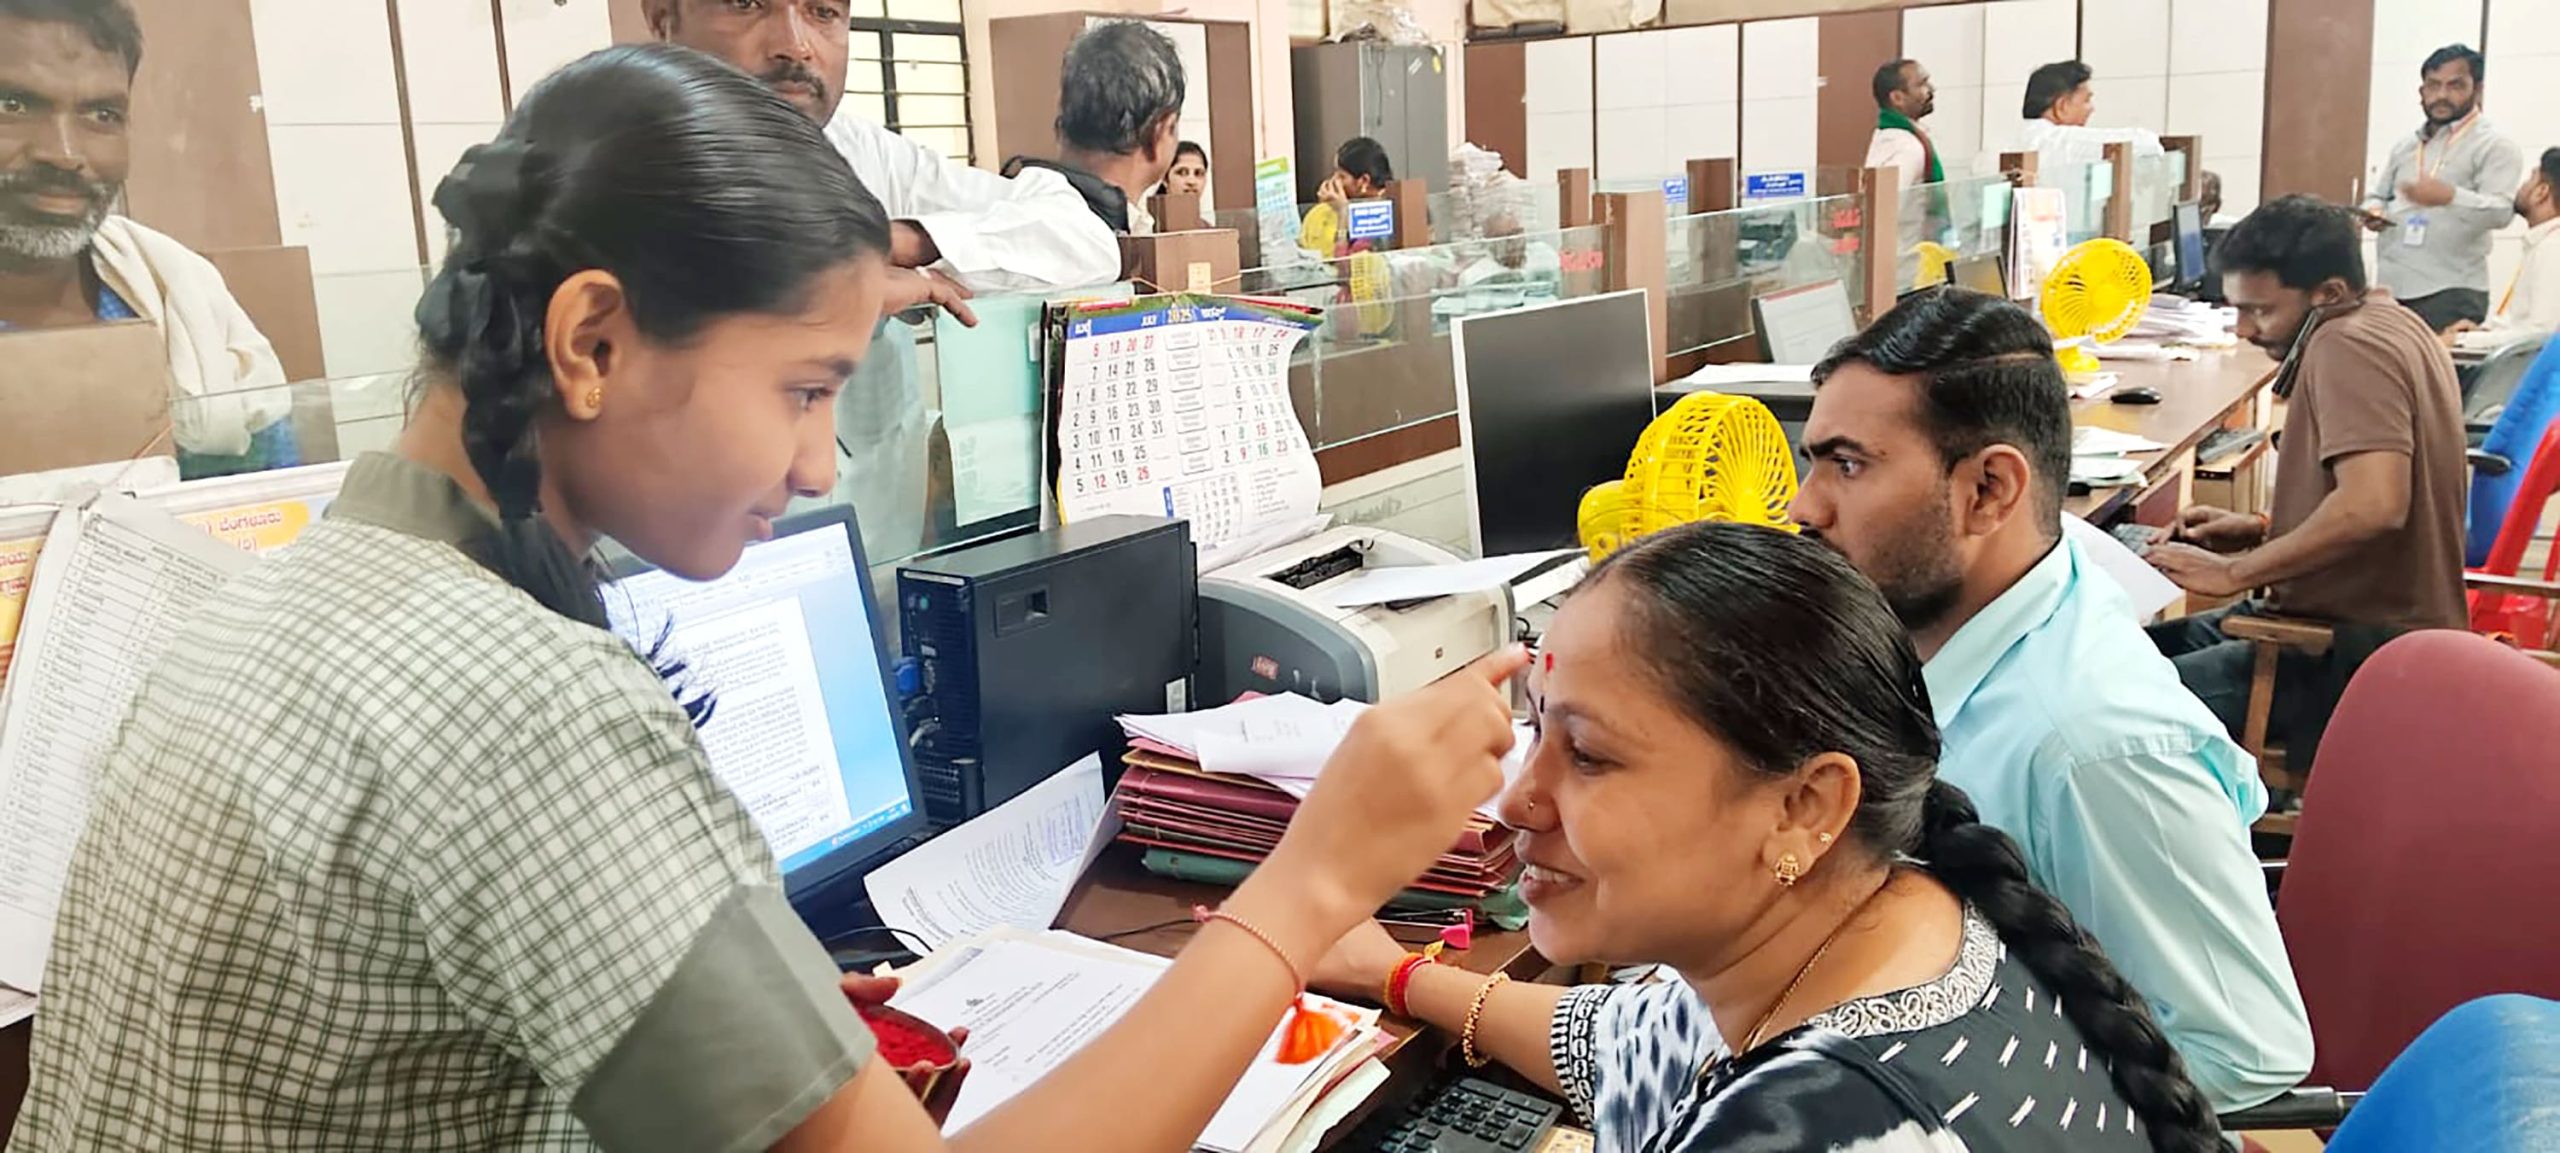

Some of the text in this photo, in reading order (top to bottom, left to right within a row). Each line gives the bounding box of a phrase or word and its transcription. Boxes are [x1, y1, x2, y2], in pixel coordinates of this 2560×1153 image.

[1143, 335, 1154, 350] 27
[1125, 361, 1135, 374] 21
[1107, 384, 1117, 398] 15
[1126, 381, 1137, 396] 22
[1146, 378, 1158, 393] 29
[1107, 405, 1118, 420] 16
[1128, 402, 1140, 417] 23
[1148, 399, 1161, 414] 30
[1088, 430, 1100, 445] 10
[1109, 427, 1120, 441] 17
[1130, 423, 1142, 438] 24
[1152, 420, 1163, 434] 31
[1256, 422, 1267, 436] 15
[1091, 453, 1102, 467] 11
[1112, 450, 1125, 463] 18
[1133, 445, 1146, 459] 25
[1258, 442, 1268, 456] 16
[1094, 473, 1107, 489] 12
[1116, 469, 1128, 484] 19
